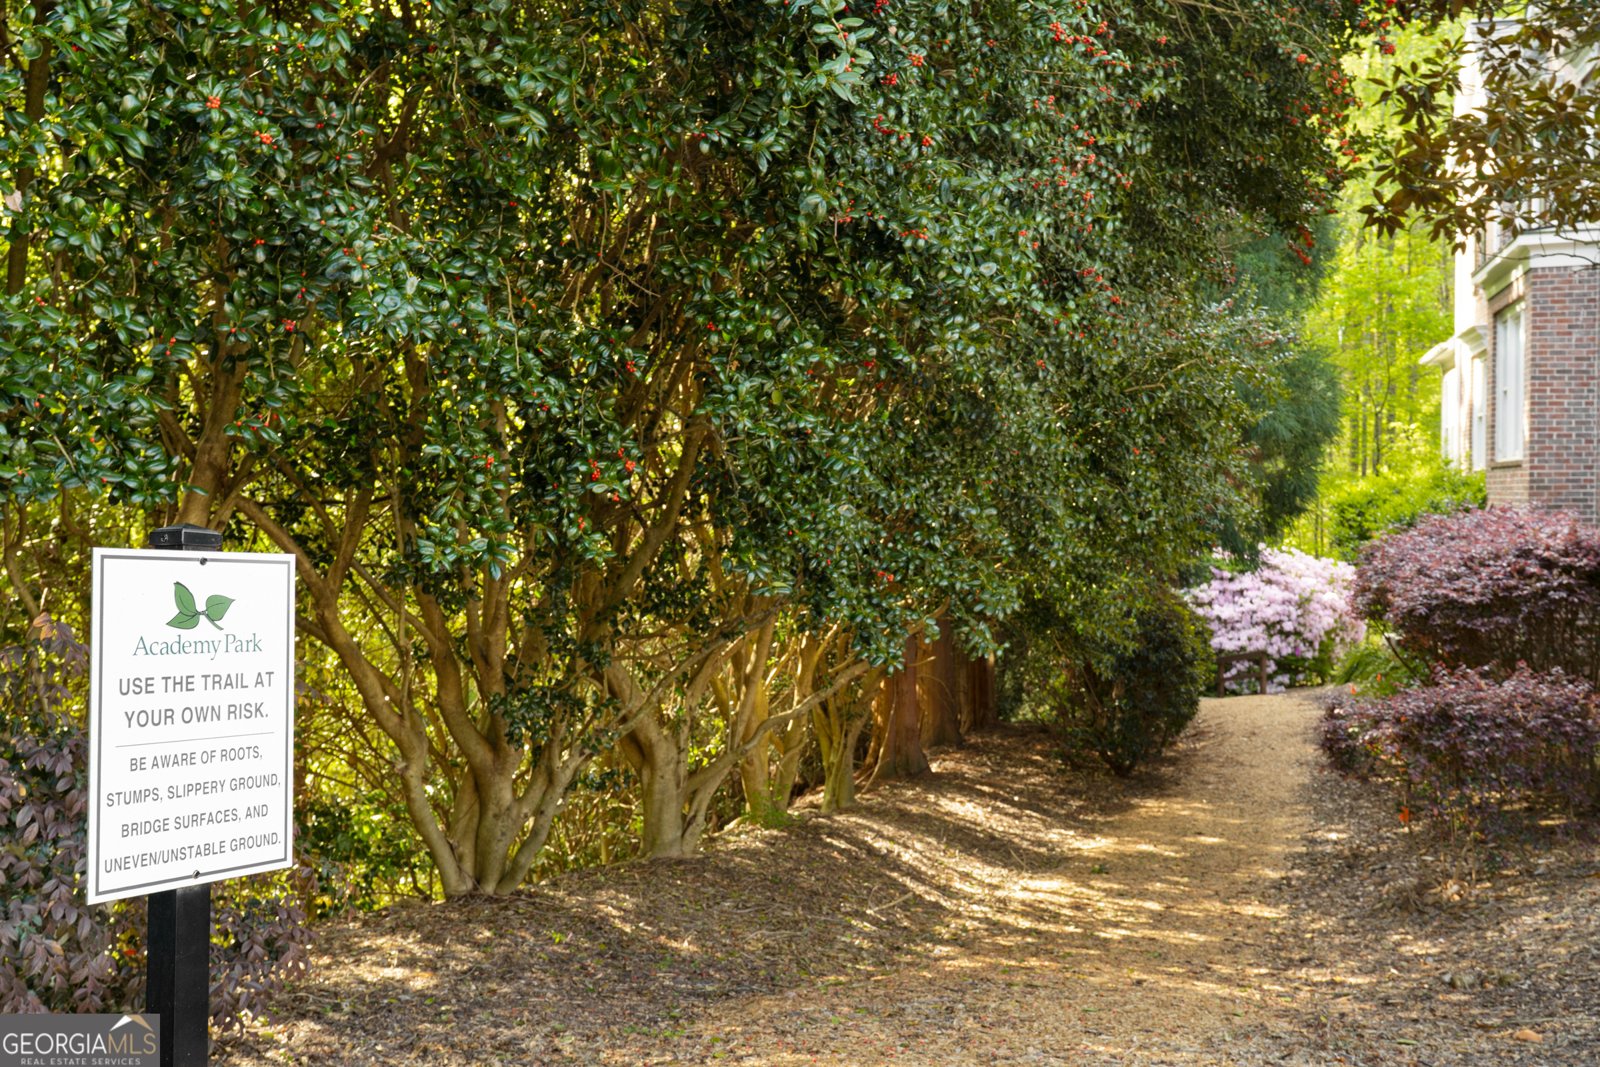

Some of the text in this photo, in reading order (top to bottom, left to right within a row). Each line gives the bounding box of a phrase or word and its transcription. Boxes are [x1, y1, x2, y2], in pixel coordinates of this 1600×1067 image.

[133, 633, 262, 660] Academy Park
[119, 672, 274, 695] USE THE TRAIL AT
[125, 702, 268, 728] YOUR OWN RISK.
[130, 746, 262, 771] BE AWARE OF ROOTS,
[106, 774, 280, 807] STUMPS, SLIPPERY GROUND,
[121, 804, 268, 837] BRIDGE SURFACES, AND
[104, 833, 281, 873] UNEVEN/UNSTABLE GROUND.
